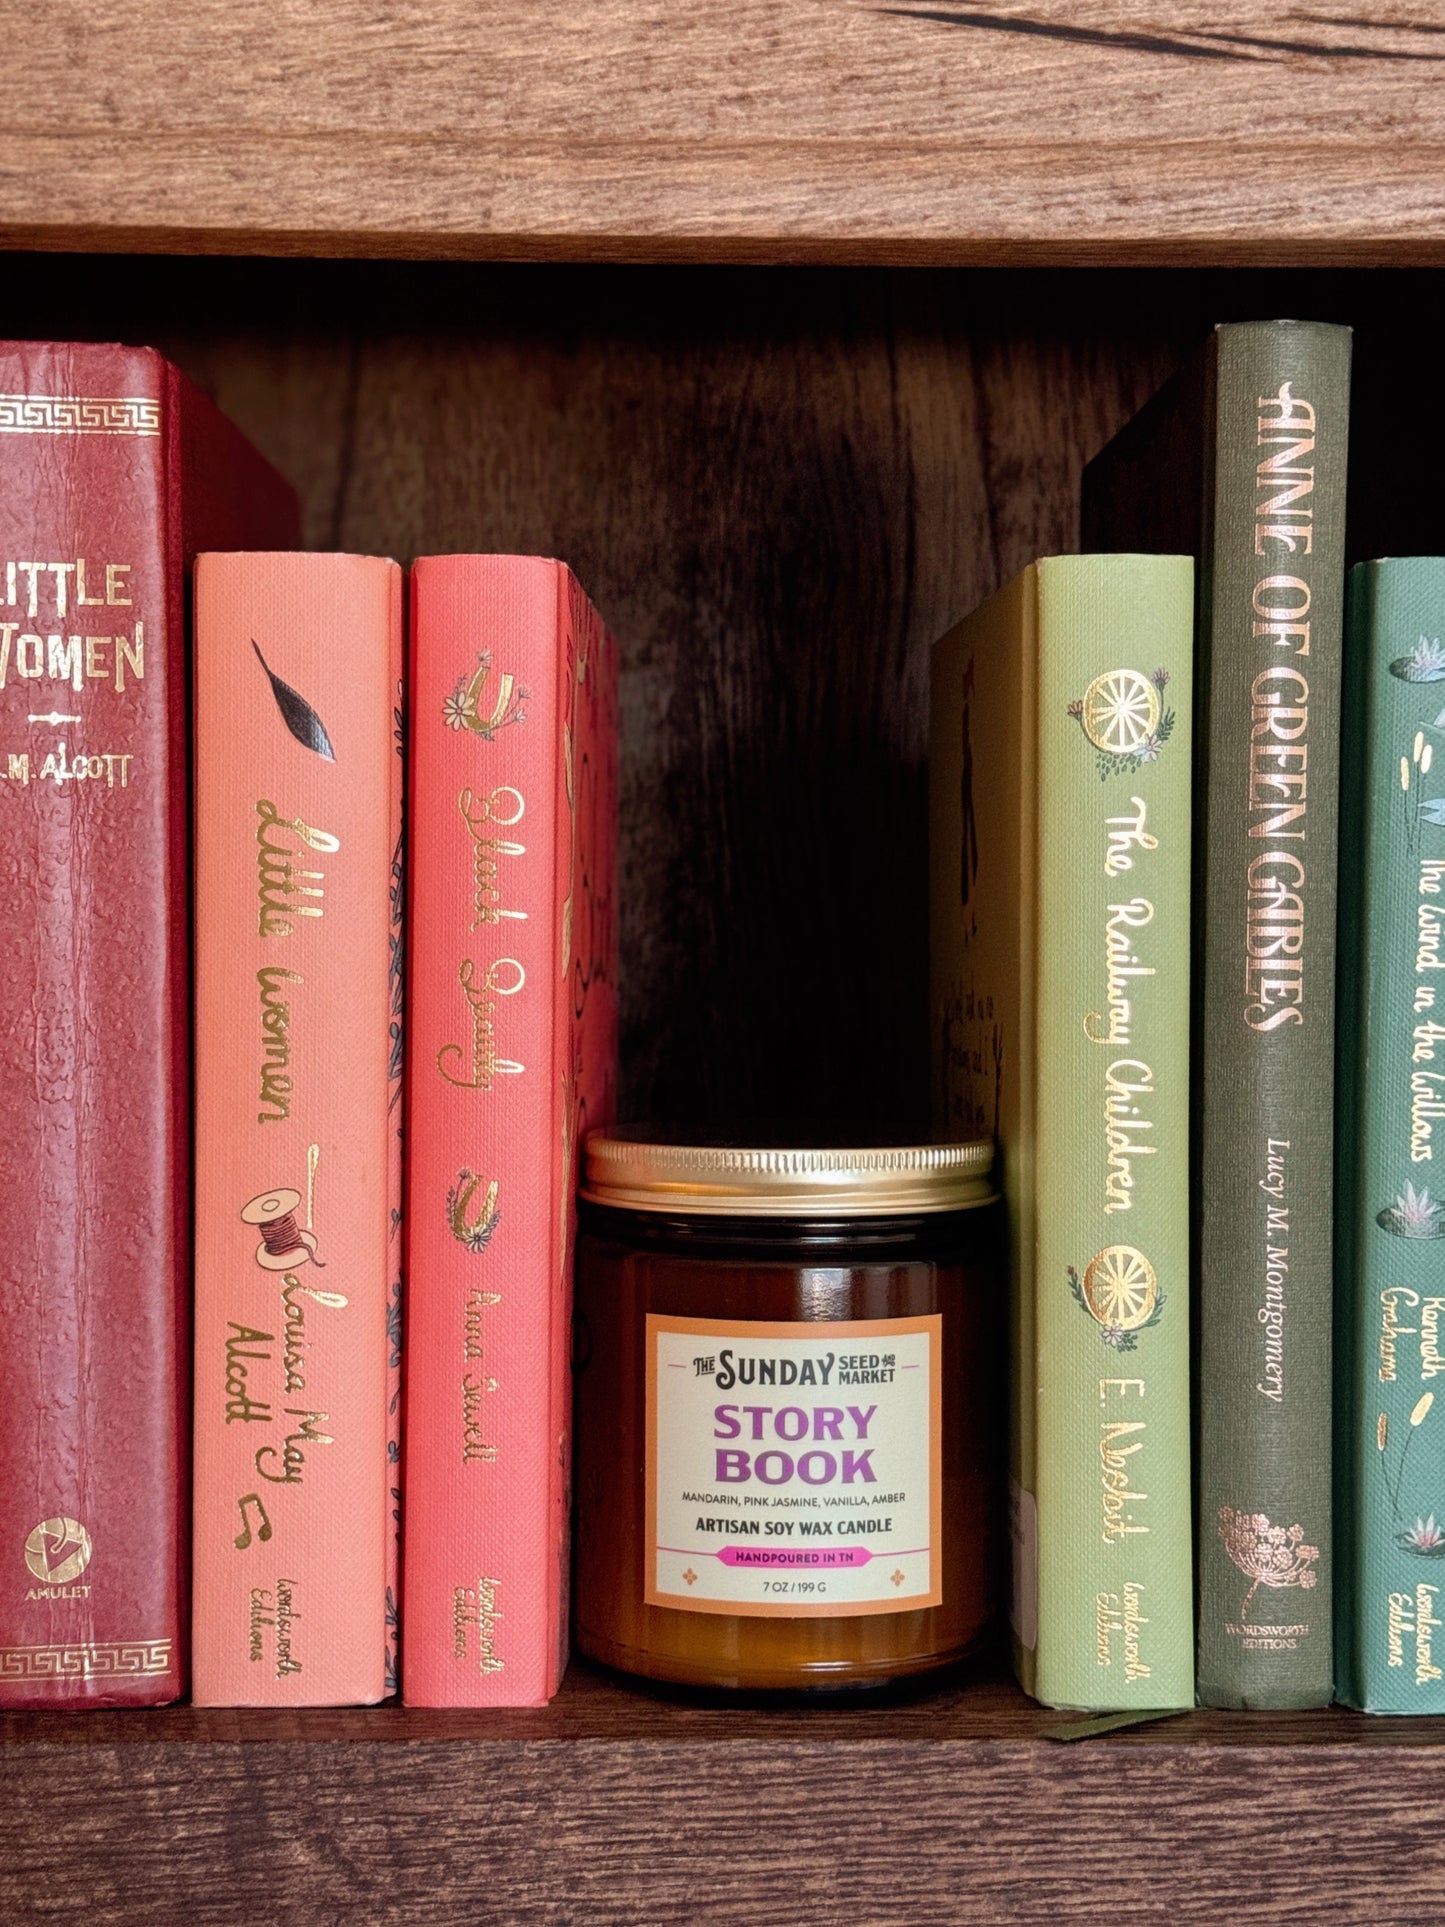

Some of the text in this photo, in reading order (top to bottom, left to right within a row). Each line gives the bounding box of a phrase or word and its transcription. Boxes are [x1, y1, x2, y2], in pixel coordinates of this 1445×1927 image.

[0, 559, 133, 618] ITTLE
[1244, 381, 1316, 1032] ANNE OF GREEN GABLES
[39, 742, 134, 788] ALCOTT
[255, 799, 341, 1124] Little Women
[436, 786, 528, 1092] Black Beauty
[1083, 796, 1159, 1215] The Railway Children
[1411, 1020, 1445, 1063] the
[1410, 1071, 1445, 1163] Willows
[1256, 1138, 1290, 1402] Lucy M. Montgomery
[1420, 1297, 1445, 1380] Kenneth
[225, 1321, 275, 1425] Alcott
[255, 1272, 349, 1483] Louisa May
[462, 1287, 502, 1464] Anna Sewell
[693, 1356, 715, 1377] THE
[716, 1349, 836, 1390] SUNDAY
[839, 1355, 880, 1370] SEED
[839, 1369, 896, 1385] MARKET
[714, 1404, 878, 1441] STORY
[715, 1448, 878, 1485] BOOK
[1099, 1378, 1150, 1544] E. Nesbit
[682, 1491, 906, 1508] MANDARIN, PINK JASMINE, VANILLA, AMBER
[695, 1517, 893, 1536] ARTISAN SOY WAX CANDLE
[735, 1551, 854, 1564] HANDPOURED IN TN
[25, 1586, 91, 1600] AMULET
[763, 1581, 827, 1593] 7 OZ / 199 G
[250, 1588, 275, 1662] Editions
[1225, 1623, 1309, 1636] WORDSWORTH
[1243, 1638, 1297, 1649] EDITIONS
